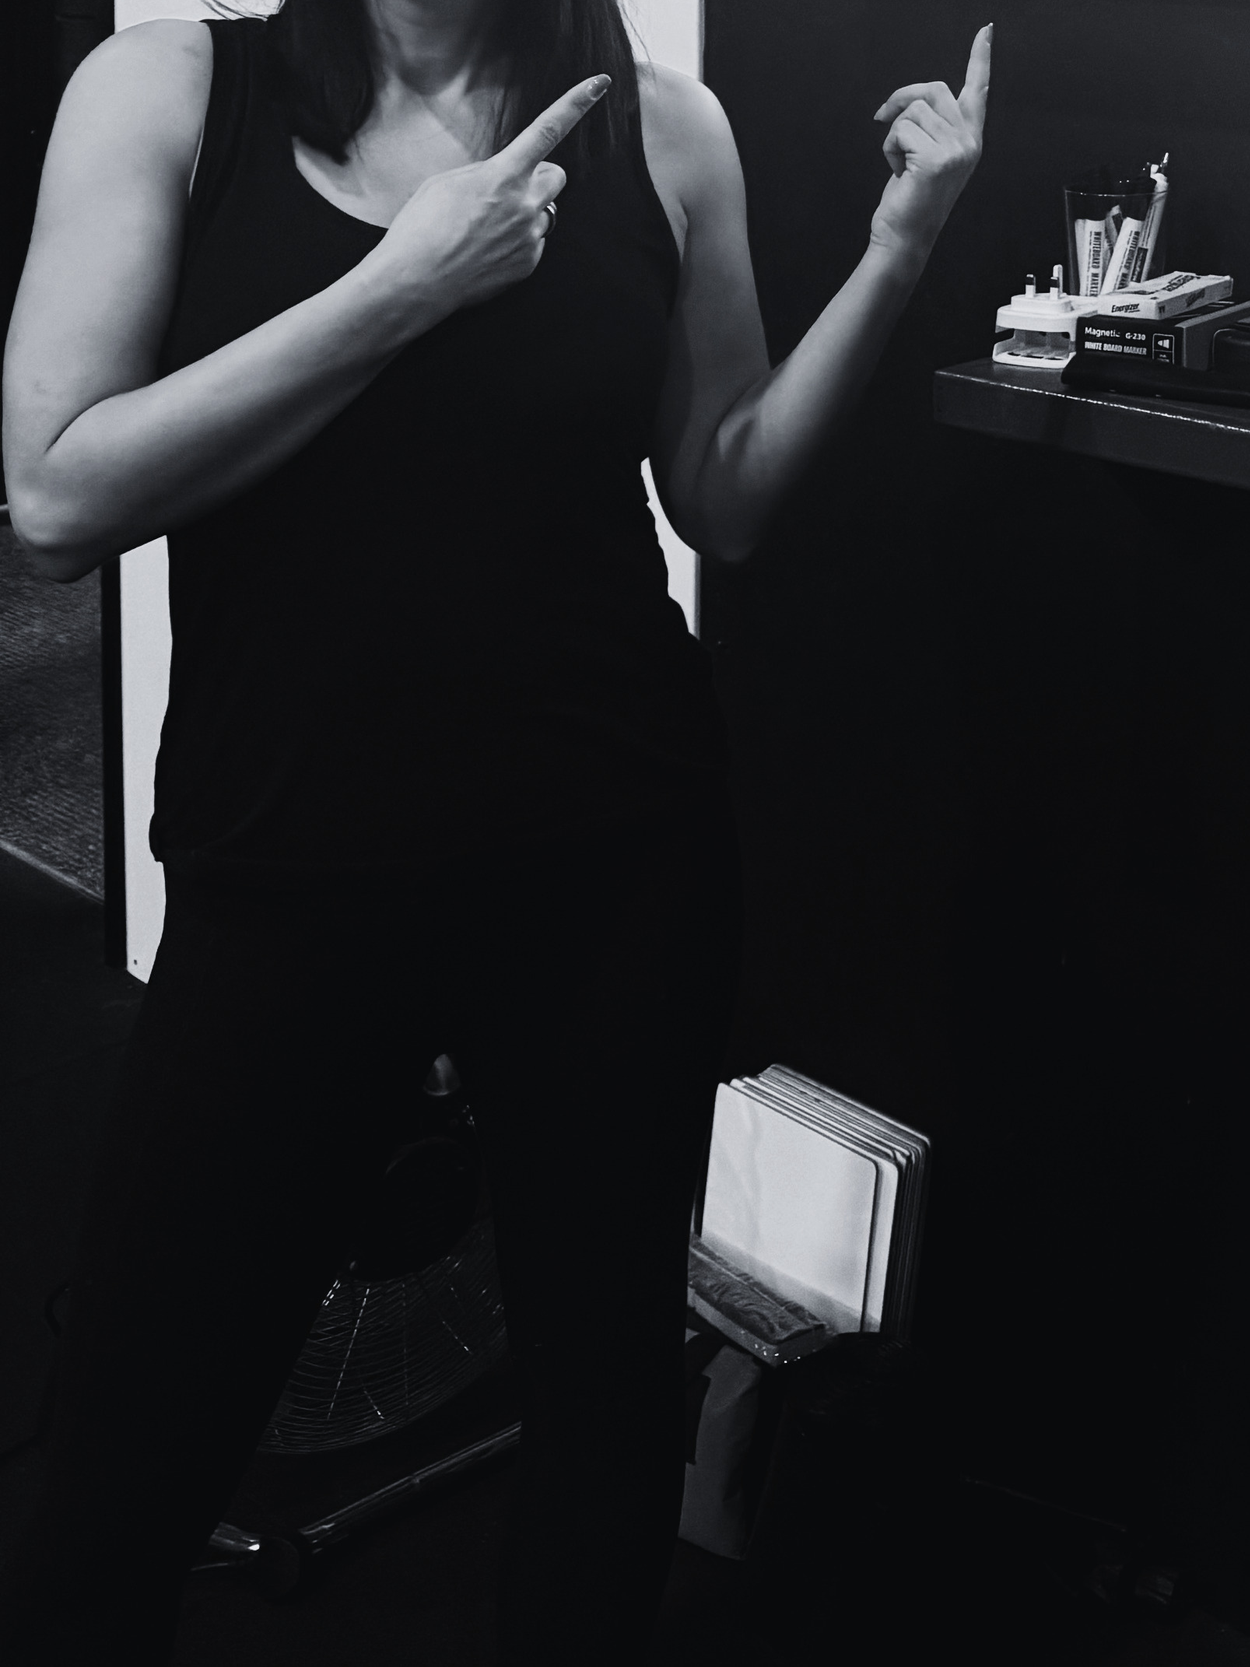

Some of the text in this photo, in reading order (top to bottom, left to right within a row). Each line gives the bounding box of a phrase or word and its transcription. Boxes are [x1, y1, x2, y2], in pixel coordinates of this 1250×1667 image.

[1091, 230, 1102, 269] WHITEBOARD
[1111, 303, 1140, 313] Energizer
[1084, 341, 1147, 355] WHITE BOARD MARKER
